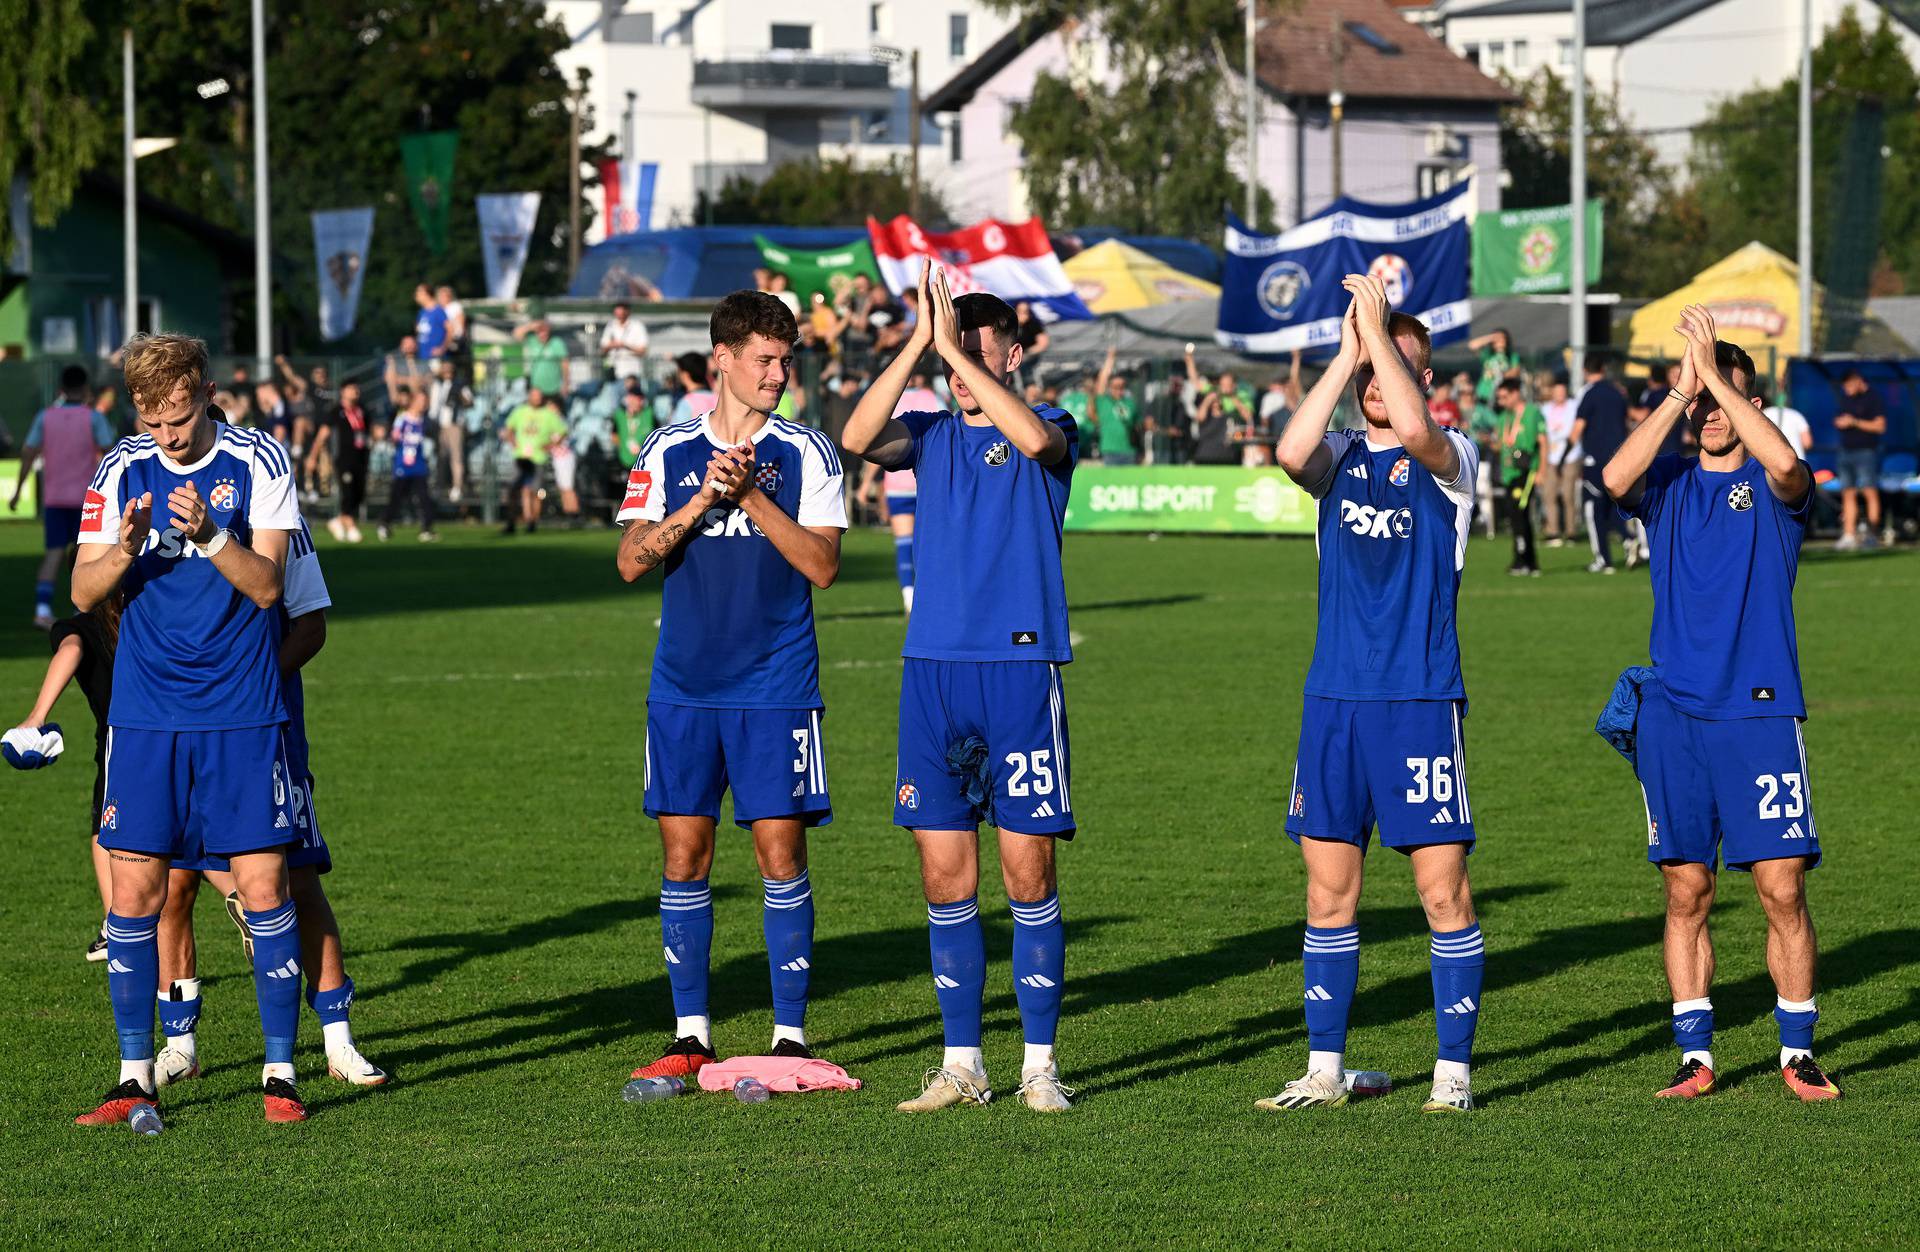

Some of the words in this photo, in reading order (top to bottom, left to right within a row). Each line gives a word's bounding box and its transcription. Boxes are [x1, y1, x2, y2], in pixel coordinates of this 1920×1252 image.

[1142, 485, 1217, 512] SPORT
[793, 728, 808, 773] 3
[1005, 749, 1054, 797] 25
[1406, 756, 1453, 804] 36
[1755, 772, 1804, 820] 23
